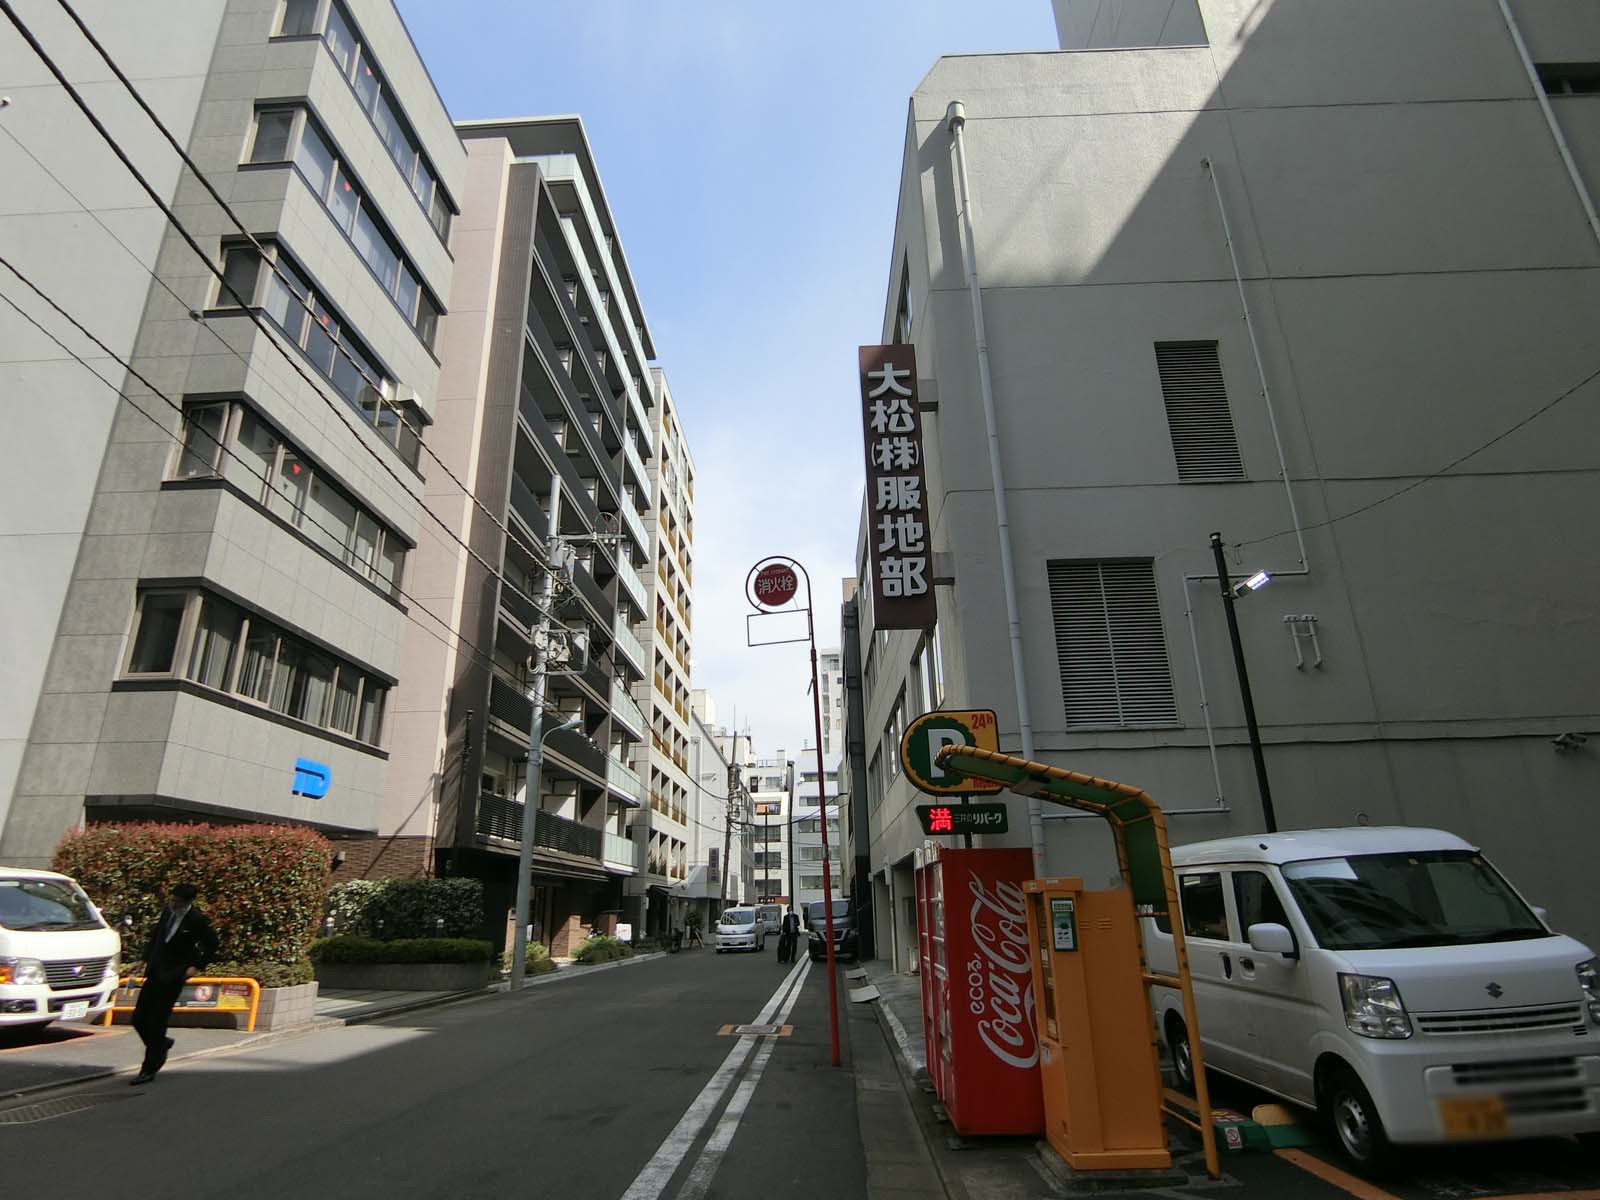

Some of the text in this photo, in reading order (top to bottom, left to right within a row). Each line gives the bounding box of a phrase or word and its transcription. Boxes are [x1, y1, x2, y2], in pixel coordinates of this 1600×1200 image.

[758, 575, 794, 595] 消火栓
[971, 713, 993, 731] 24h
[927, 728, 967, 779] P
[929, 807, 953, 831] 満
